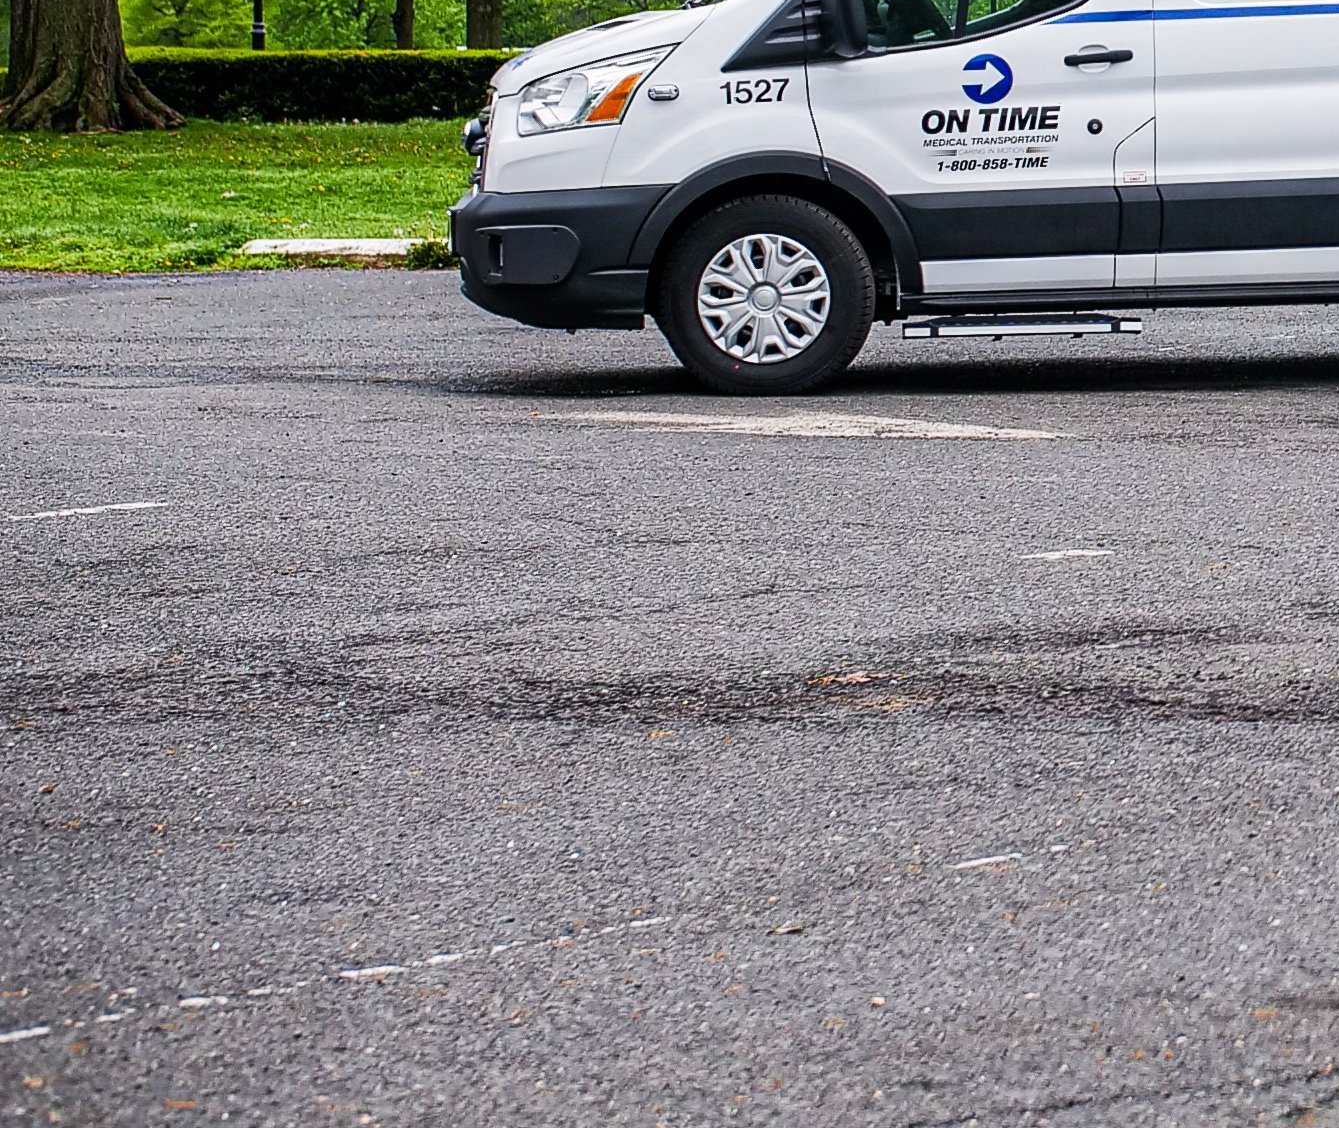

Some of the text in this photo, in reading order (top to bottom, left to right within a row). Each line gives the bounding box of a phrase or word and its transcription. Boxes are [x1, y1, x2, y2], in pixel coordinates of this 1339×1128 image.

[719, 78, 790, 105] 1527
[921, 105, 1061, 135] ON TIME
[922, 134, 1059, 148] MEDICAL TRANSPORTATION
[937, 156, 1050, 173] 1-800-858-TIME
